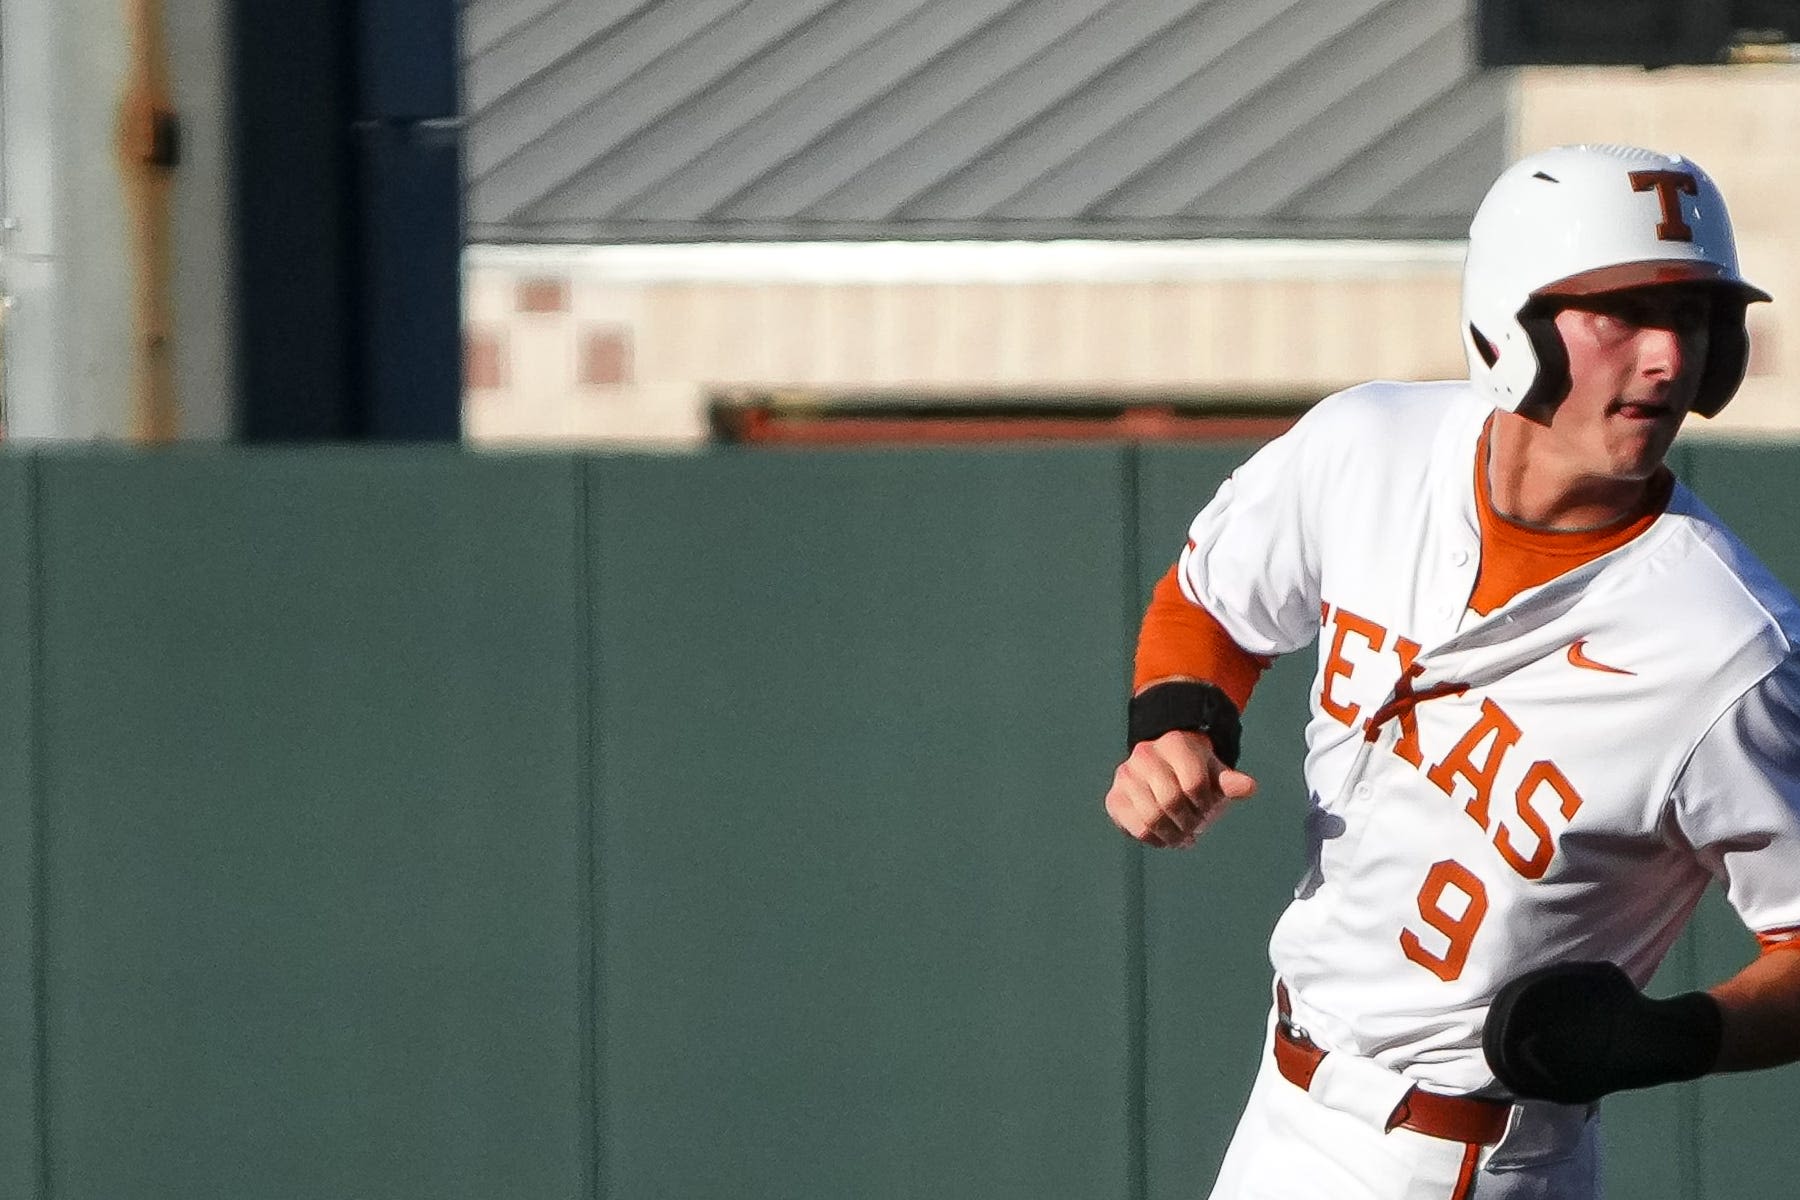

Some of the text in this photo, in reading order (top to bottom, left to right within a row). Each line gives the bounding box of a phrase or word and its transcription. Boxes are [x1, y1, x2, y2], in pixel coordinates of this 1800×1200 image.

[1627, 169, 1698, 242] T
[1320, 598, 1584, 880] EXAS
[1399, 858, 1489, 982] 9
